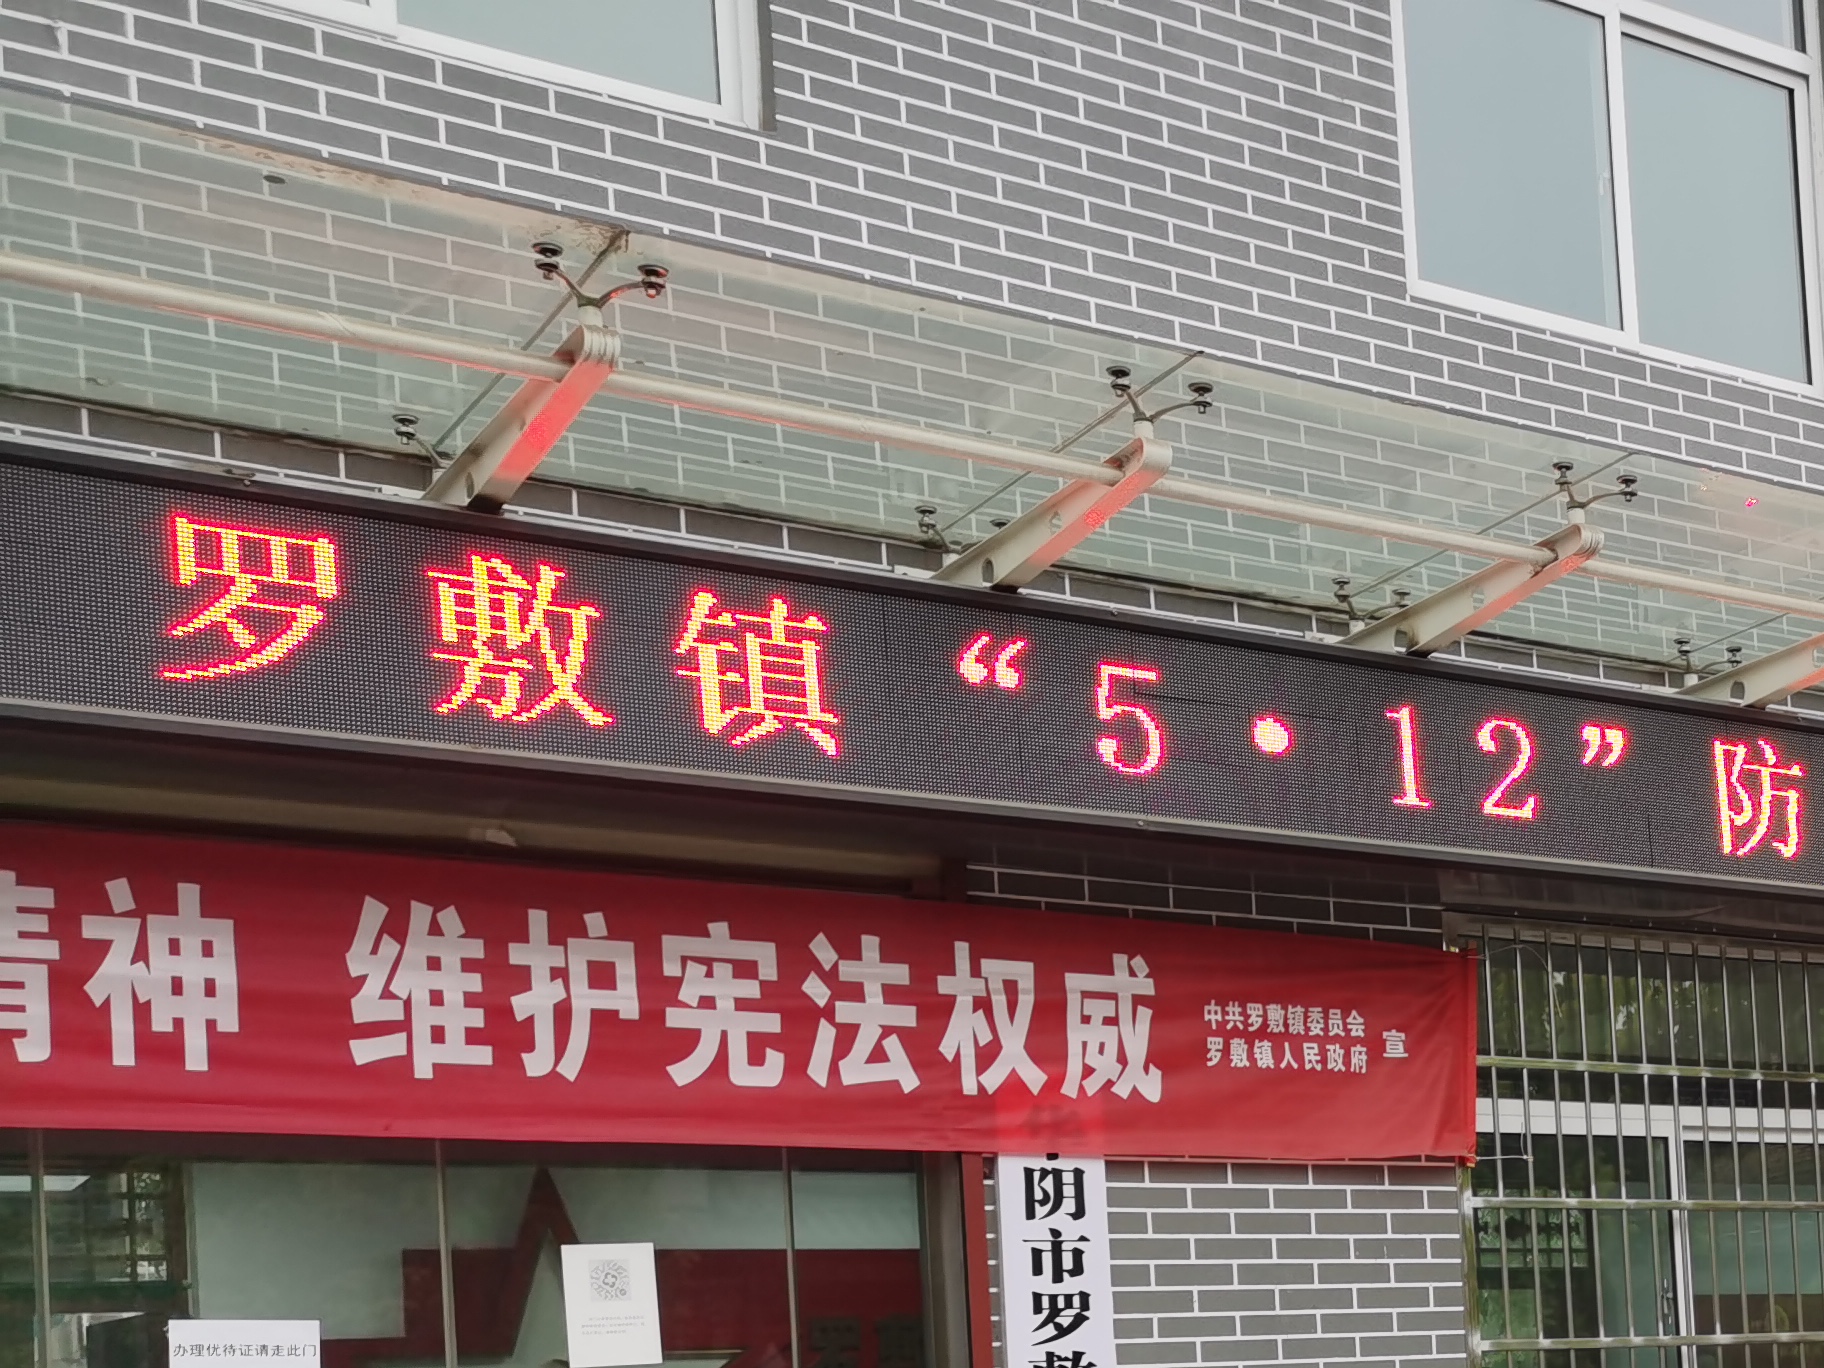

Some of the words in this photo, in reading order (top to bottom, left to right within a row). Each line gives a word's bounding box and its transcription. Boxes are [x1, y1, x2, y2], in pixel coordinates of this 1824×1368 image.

[345, 894, 1162, 1104] 维护宪法权威
[1203, 999, 1366, 1038] 中共罗敷镇委员会
[1206, 1036, 1368, 1074] 罗敷镇人民政府
[1382, 1029, 1409, 1058] 宣
[173, 1343, 317, 1358] 办理优待证请走此门
